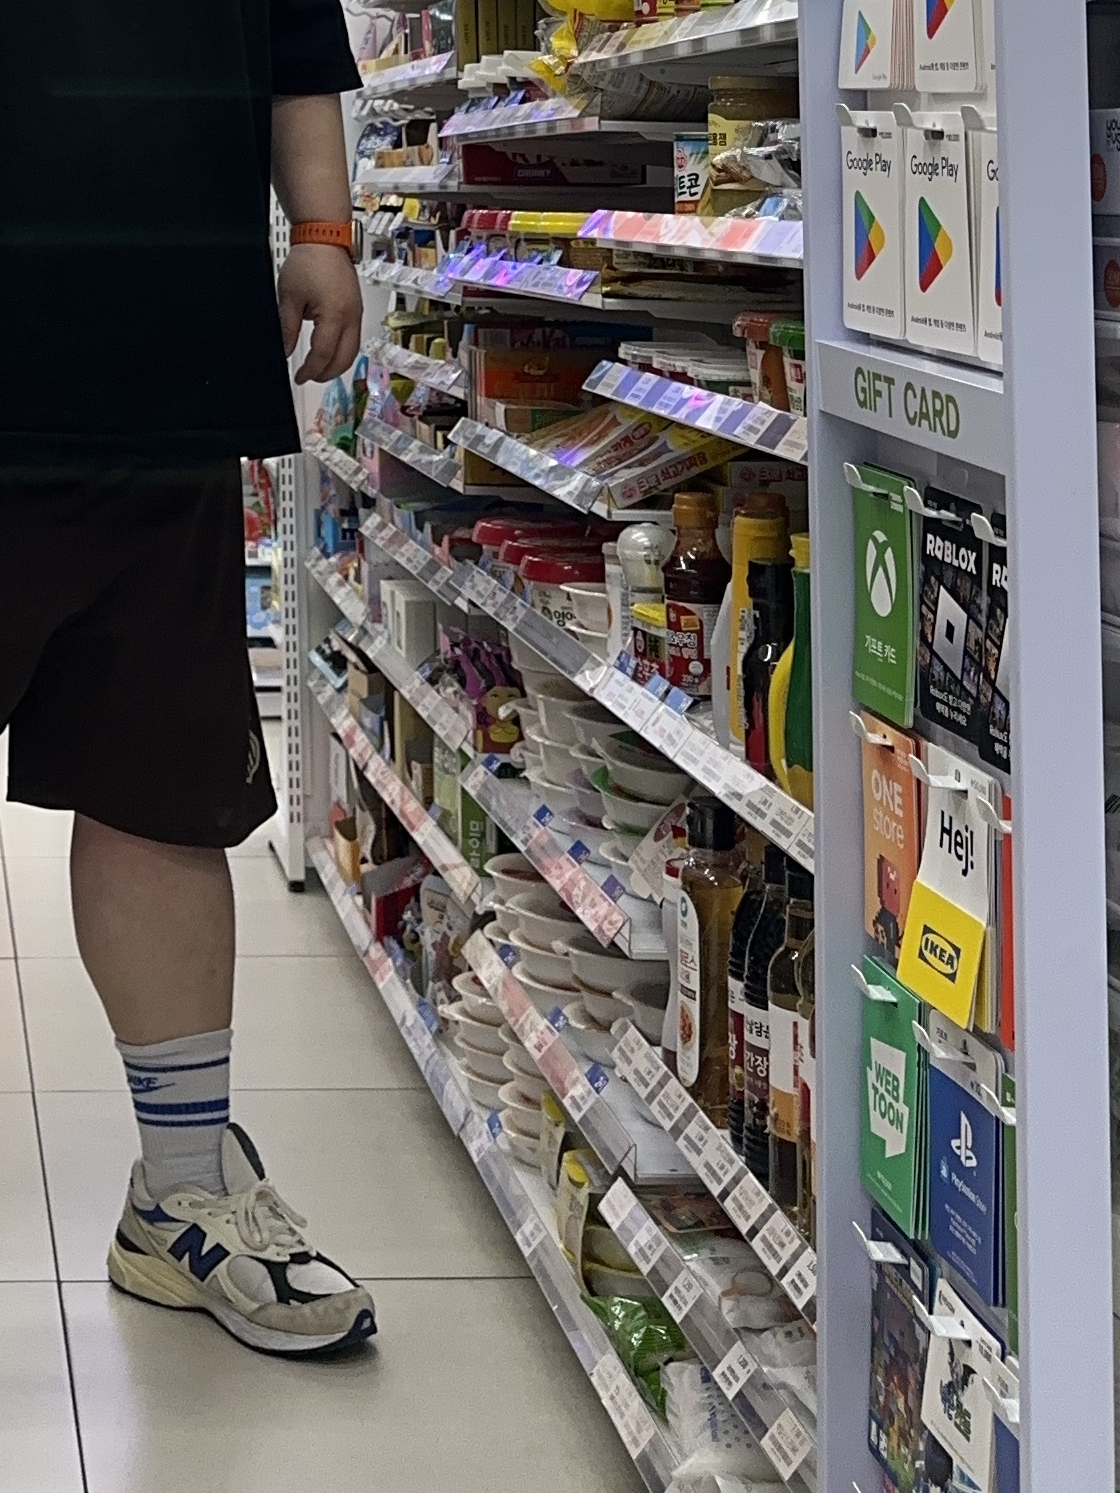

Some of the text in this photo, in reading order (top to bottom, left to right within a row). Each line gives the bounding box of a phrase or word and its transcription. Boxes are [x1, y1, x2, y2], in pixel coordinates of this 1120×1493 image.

[846, 150, 892, 178] Google Play
[910, 155, 940, 182] Google
[941, 157, 959, 182] Play
[854, 367, 960, 440] GIFT CARD
[926, 533, 977, 575] ROBLOX
[865, 634, 897, 665] 기프트 카드
[871, 768, 903, 818] ONE
[872, 807, 905, 849] store
[939, 809, 974, 877] Hej!
[923, 937, 955, 969] IKEA
[874, 1060, 901, 1104] WEB
[871, 1082, 904, 1135] TOON
[168, 1223, 230, 1283] N
